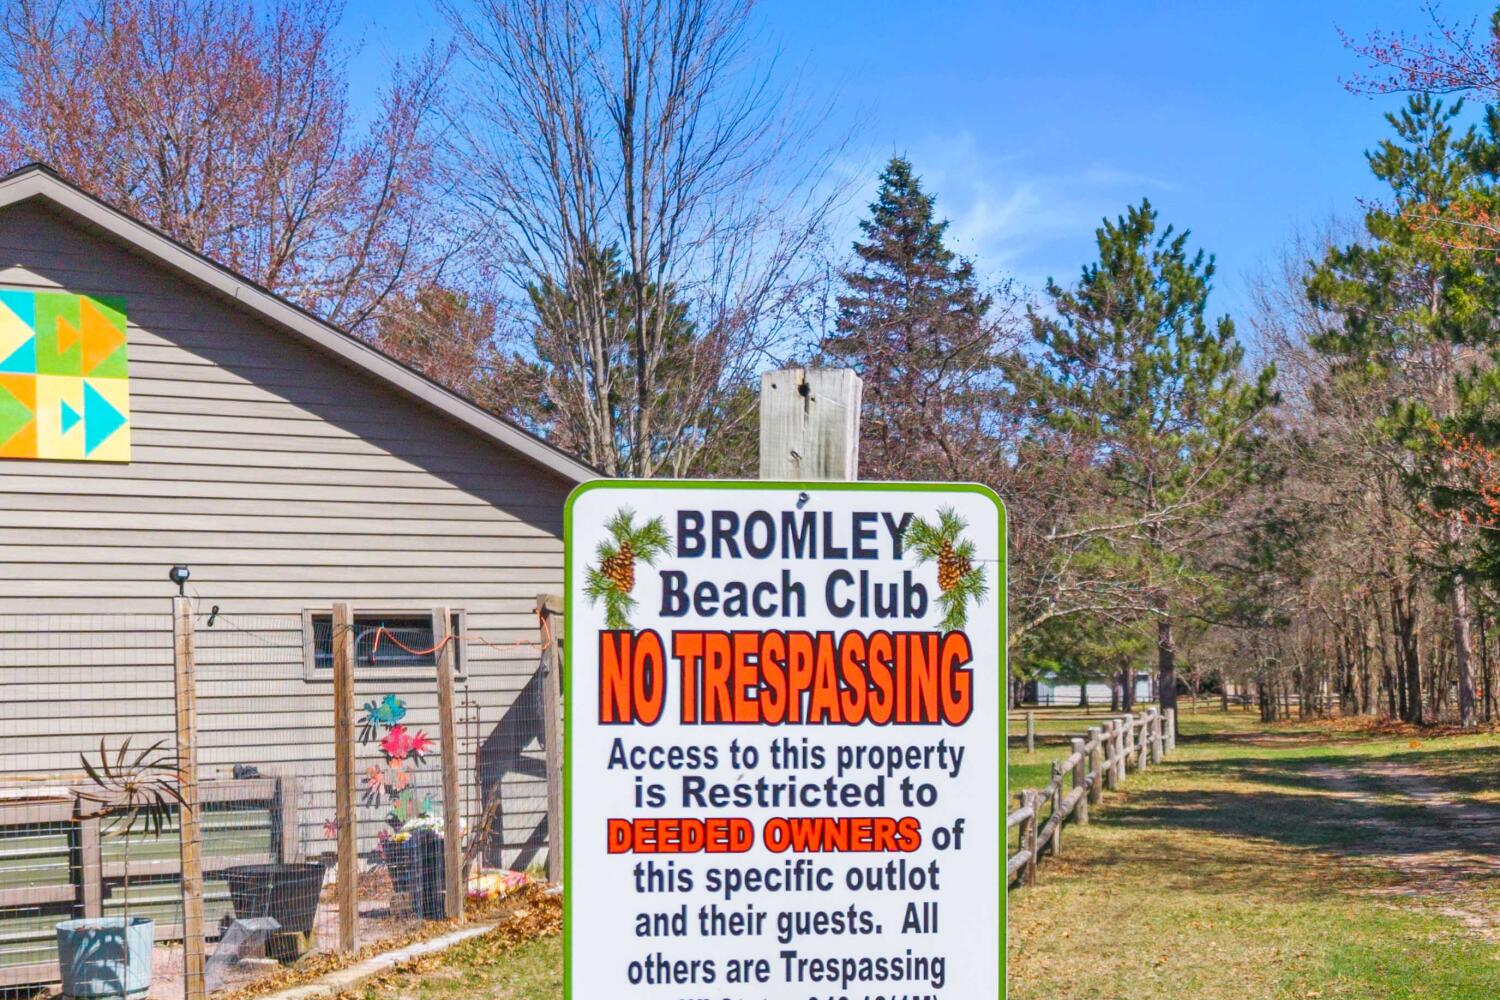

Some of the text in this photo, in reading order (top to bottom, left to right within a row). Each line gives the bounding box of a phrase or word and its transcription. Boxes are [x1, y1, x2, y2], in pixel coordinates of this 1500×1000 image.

[677, 509, 914, 560] BROMLEY
[659, 569, 928, 619] Beach Club
[598, 629, 974, 726] NO TRESPASSING
[608, 737, 966, 778] Access to this property
[634, 775, 938, 808] is Restricted to
[607, 817, 965, 853] DEEDED OWNERS of
[633, 860, 940, 900] this specific outlot
[635, 902, 939, 944] and their guests. All
[627, 950, 946, 989] others are Trespassing
